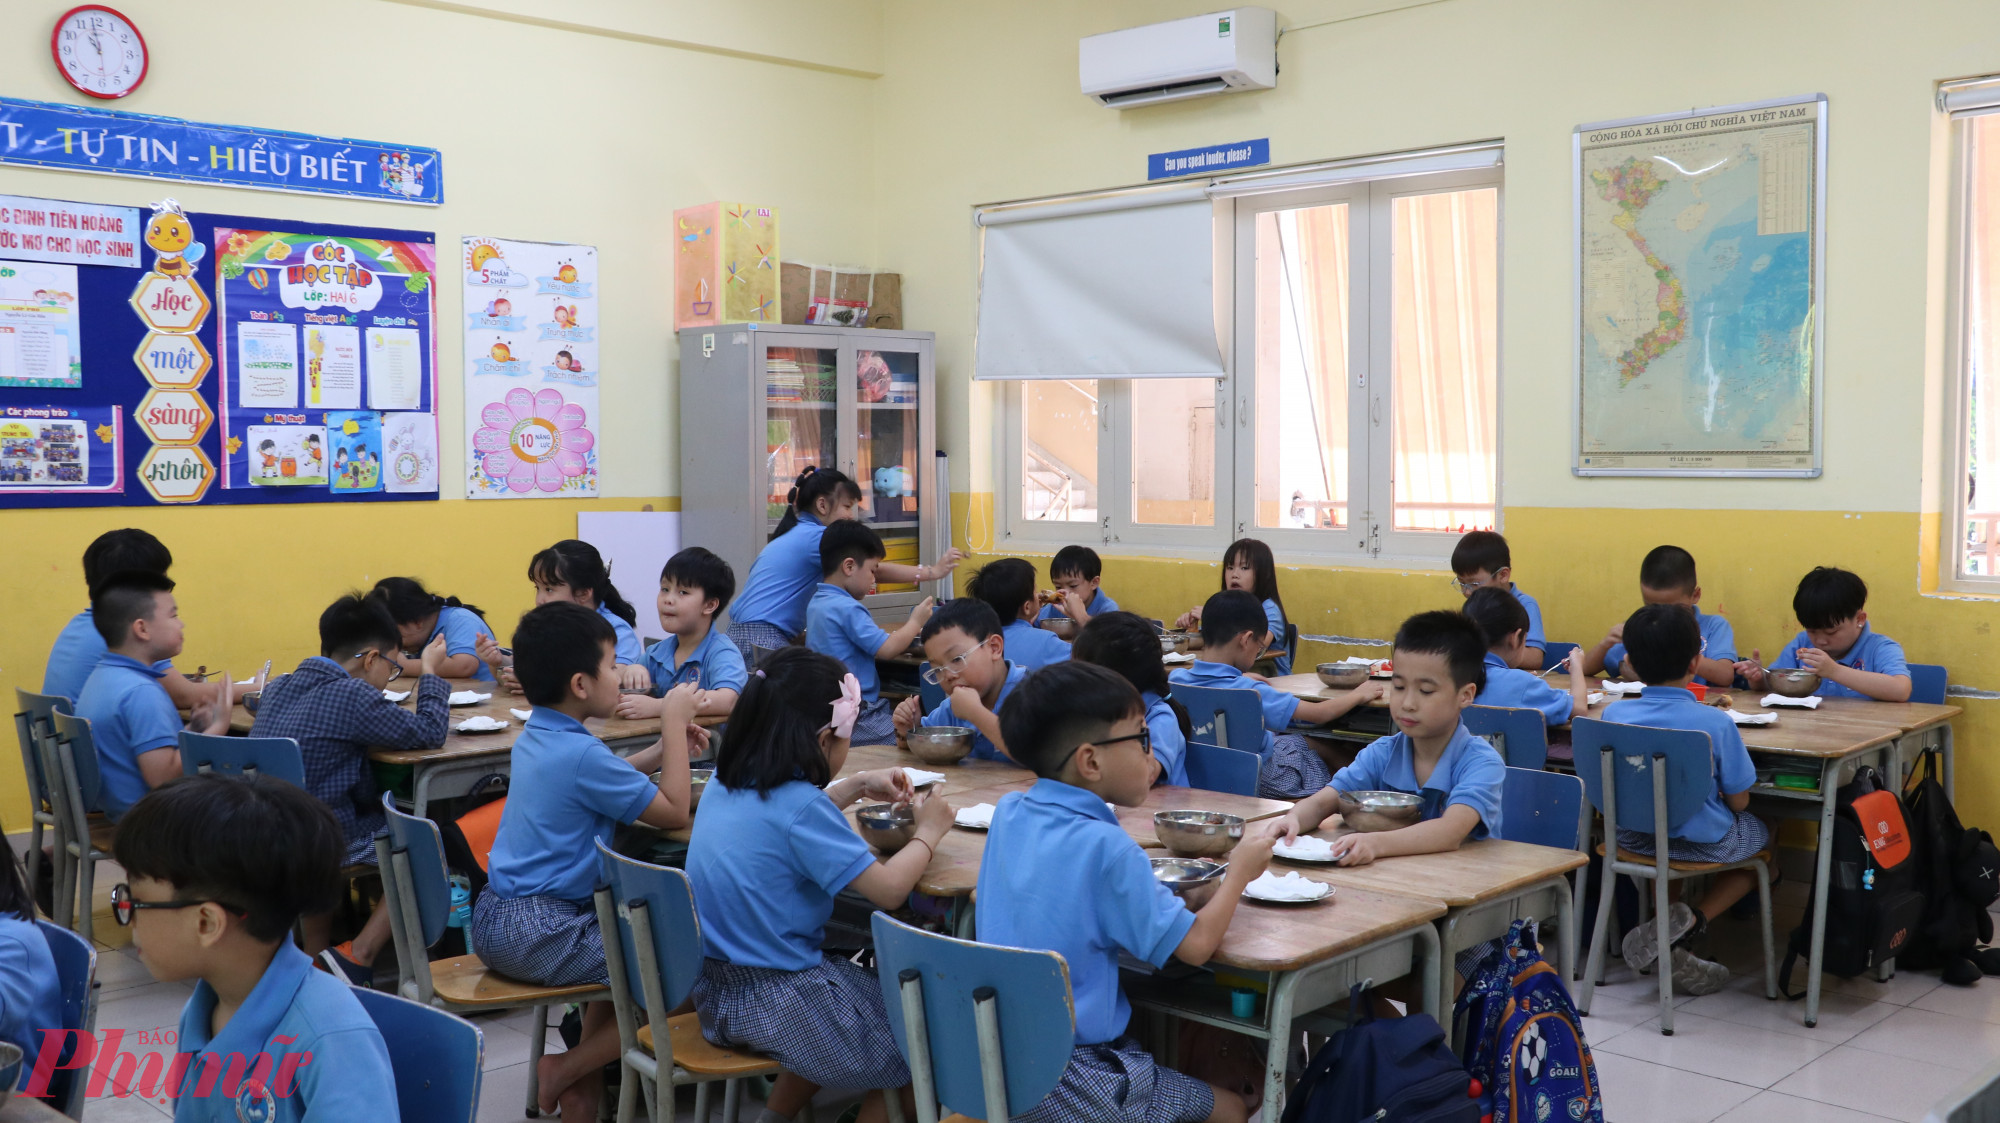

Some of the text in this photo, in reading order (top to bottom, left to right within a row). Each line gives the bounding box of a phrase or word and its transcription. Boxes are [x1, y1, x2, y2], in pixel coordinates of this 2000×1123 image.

[76, 19, 86, 29] 11
[109, 22, 115, 32] 1
[65, 30, 77, 40] 10
[121, 34, 128, 44] 2
[63, 45, 71, 55] 9
[126, 49, 134, 60] 3
[69, 61, 77, 70] 8
[123, 65, 130, 74] 4
[83, 73, 89, 83] 7
[98, 78, 106, 88] 6
[114, 75, 121, 85] 5
[1590, 107, 1806, 143] CỘNG HÒA XÃ HỘI CHỦ NGHĨA VIỆT NAM
[57, 127, 108, 164] TỰ
[116, 134, 178, 165] TIN
[209, 137, 291, 176] HIỂU
[300, 147, 367, 184] BIẾT
[1164, 157, 1176, 171] Can
[1176, 157, 1187, 171] you
[1188, 152, 1205, 169] speak
[1206, 150, 1226, 164] louder,
[1226, 148, 1247, 164] please
[49, 209, 77, 230] TIÊN
[81, 213, 123, 233] HOÀNG
[0, 228, 134, 258] ỚC MƠ CHO HỌC SINH
[287, 263, 373, 290] HỌC TẬP
[481, 268, 490, 283] 5
[350, 292, 357, 304] 6
[150, 346, 197, 375] một
[7, 407, 69, 419] Các phong trào
[148, 402, 200, 434] sàng
[520, 433, 534, 448] 10
[1549, 1067, 1579, 1078] GOAL!
